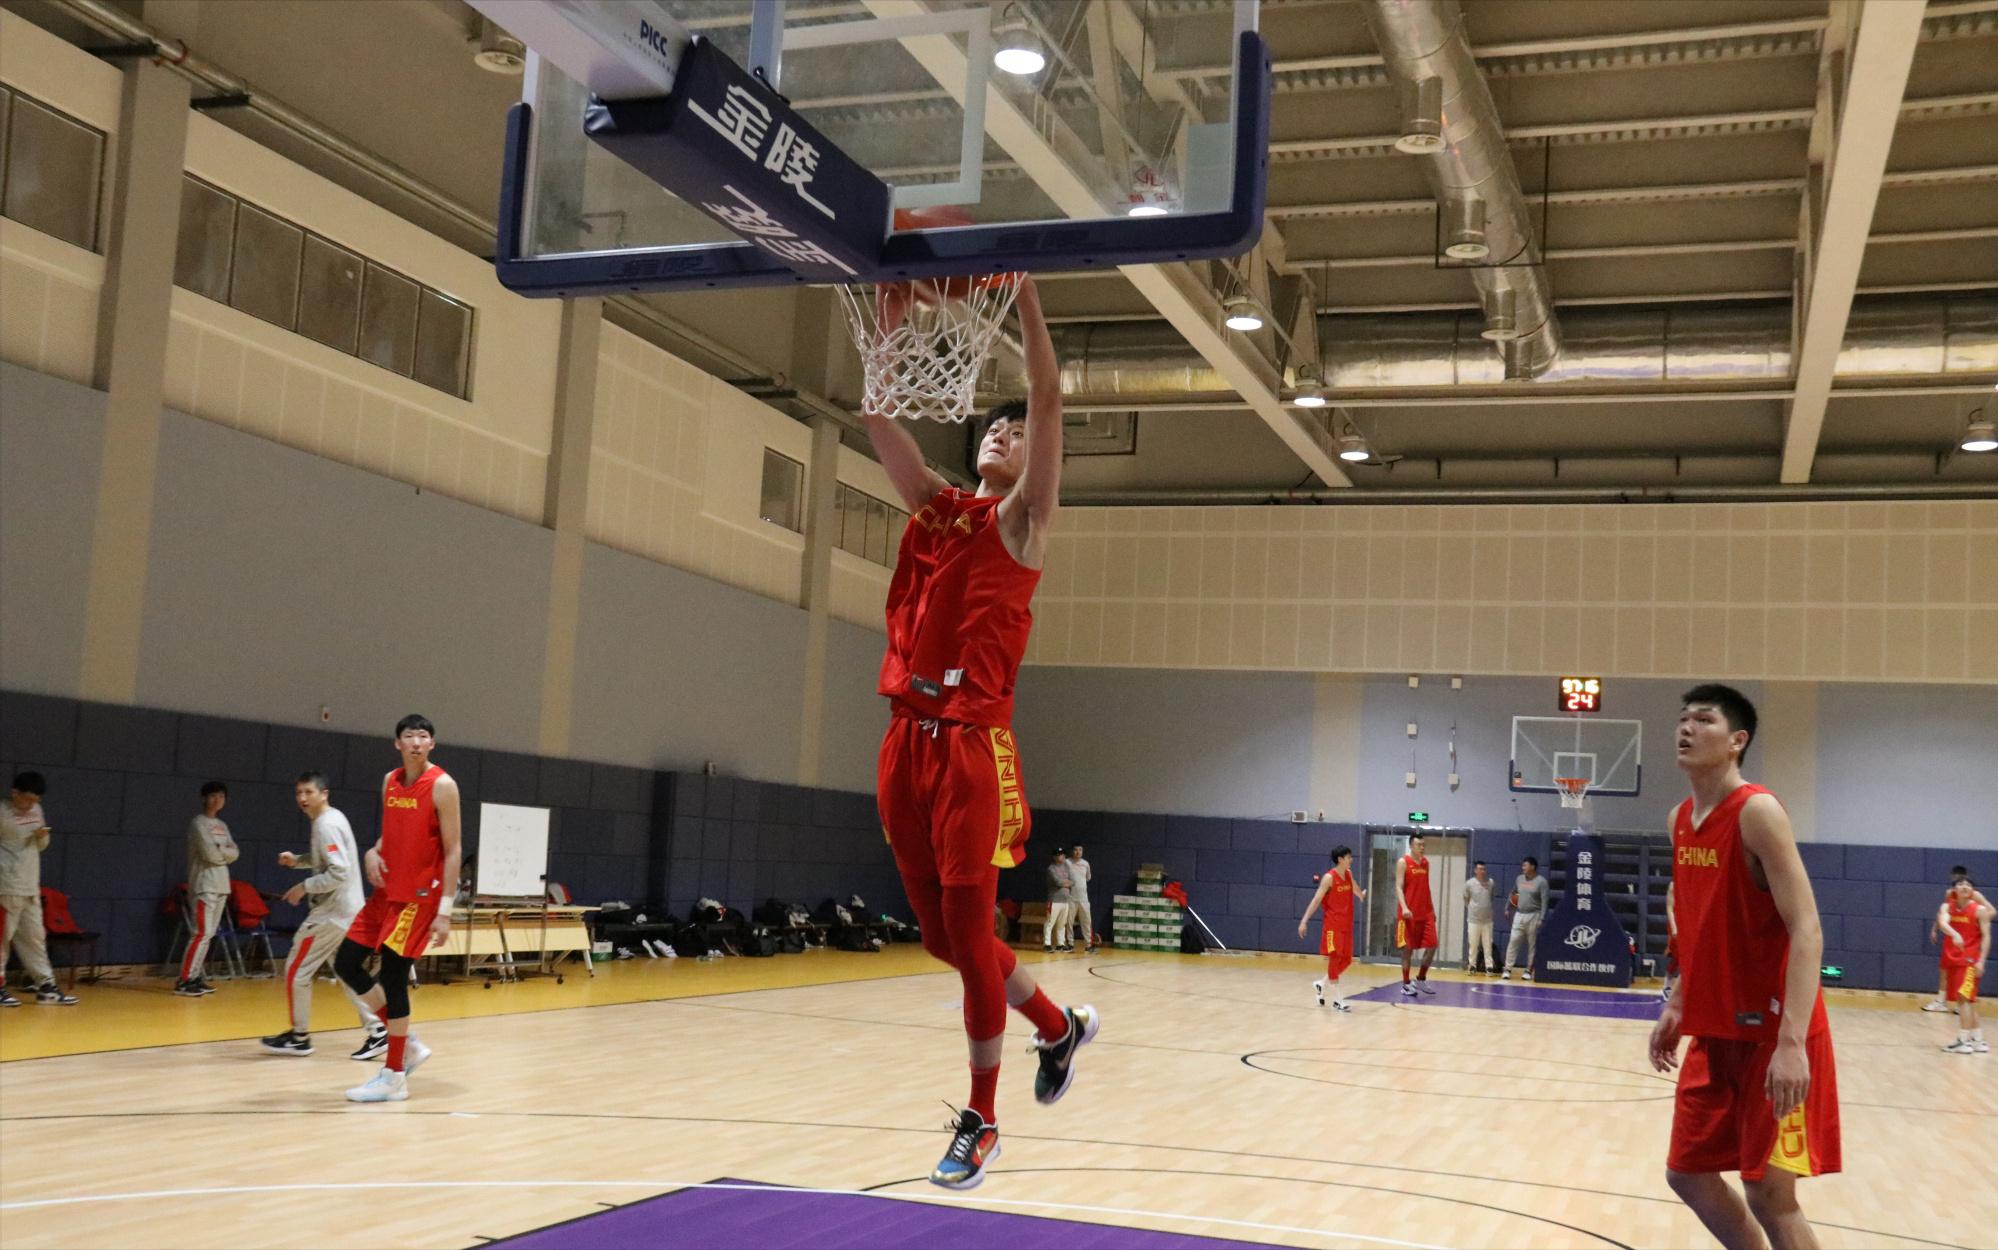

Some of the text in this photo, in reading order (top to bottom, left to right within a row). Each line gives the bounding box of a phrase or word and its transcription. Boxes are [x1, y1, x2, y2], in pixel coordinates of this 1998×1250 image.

[640, 19, 668, 57] PICC
[688, 83, 836, 220] 金陵
[1567, 692, 1593, 709] 24
[387, 797, 417, 809] CHINA
[1678, 846, 1719, 868] CHINA
[1576, 851, 1593, 911] 金陵体育
